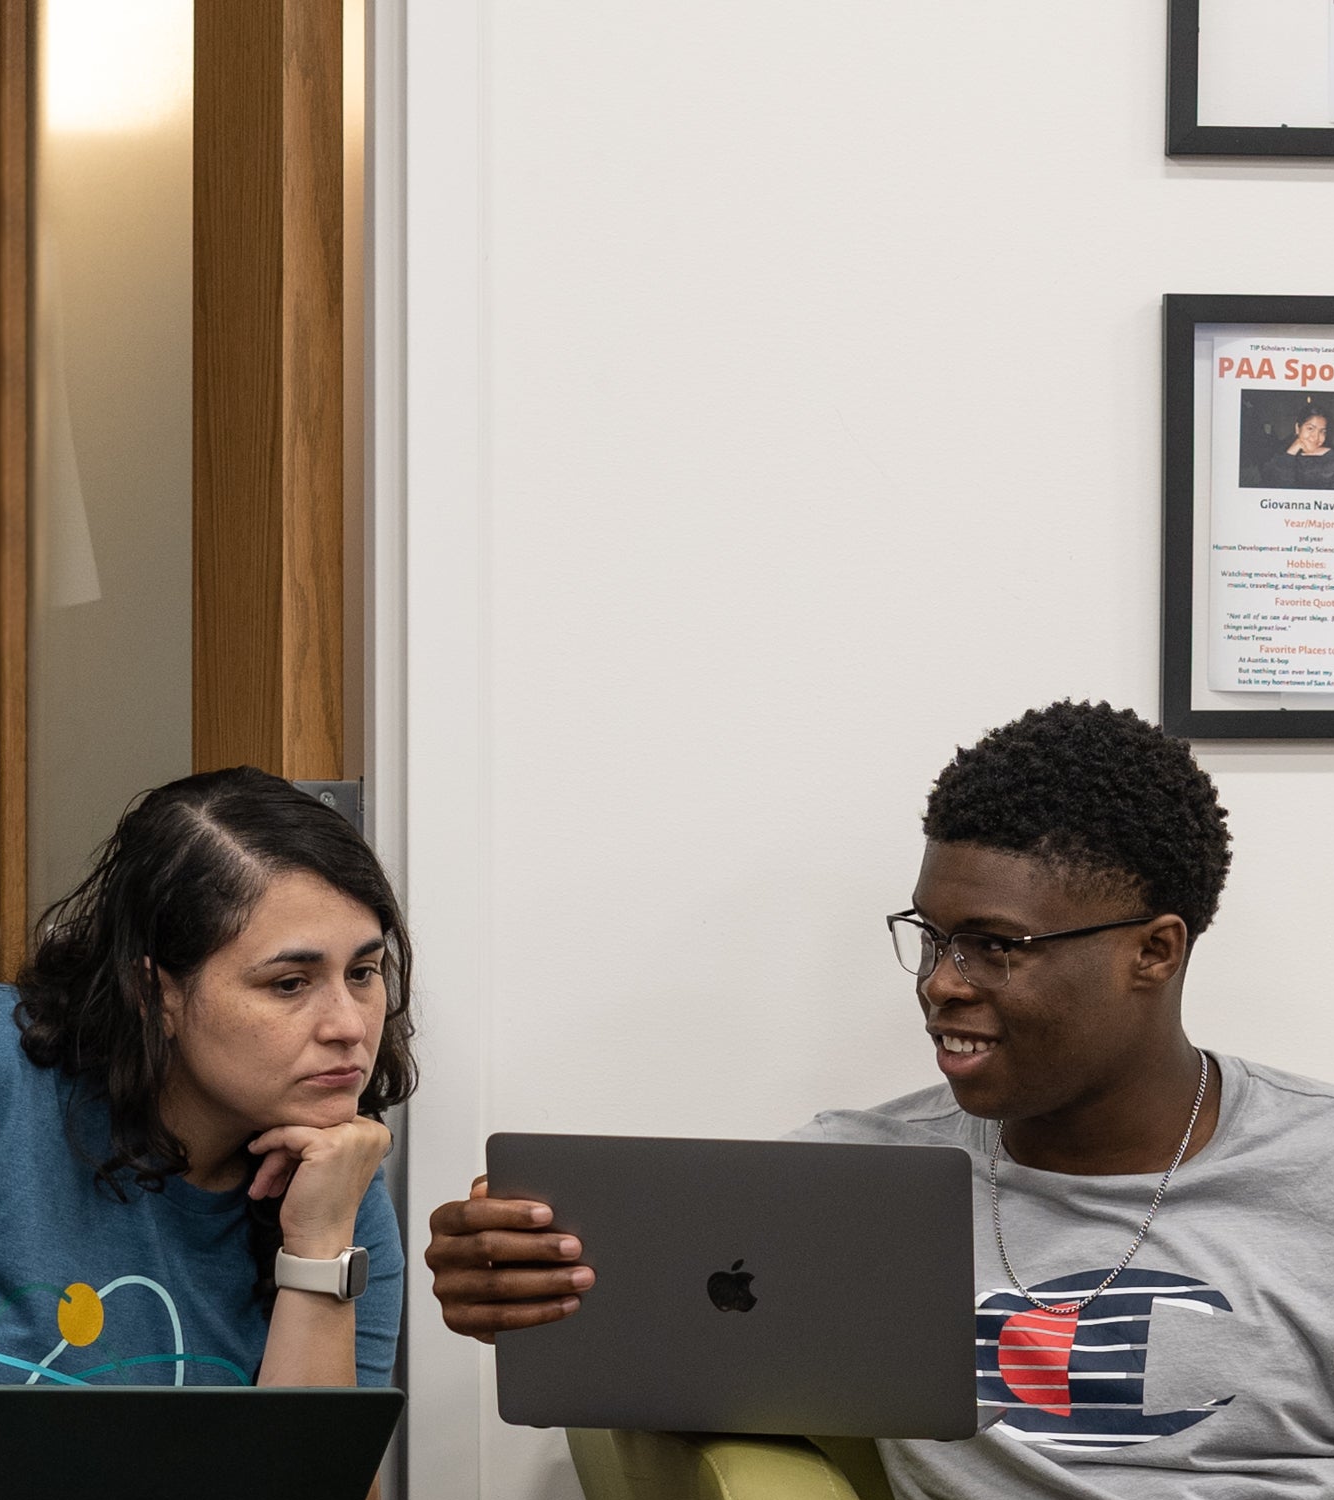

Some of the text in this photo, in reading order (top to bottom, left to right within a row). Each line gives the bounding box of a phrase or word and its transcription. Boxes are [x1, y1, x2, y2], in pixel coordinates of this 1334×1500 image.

[1218, 357, 1276, 379] PAA
[1260, 499, 1311, 510] Giovanna
[1287, 560, 1326, 569] Hobbies:
[1275, 598, 1311, 606] Favorite
[1260, 645, 1296, 654] Favorite
[1298, 646, 1326, 655] Places
